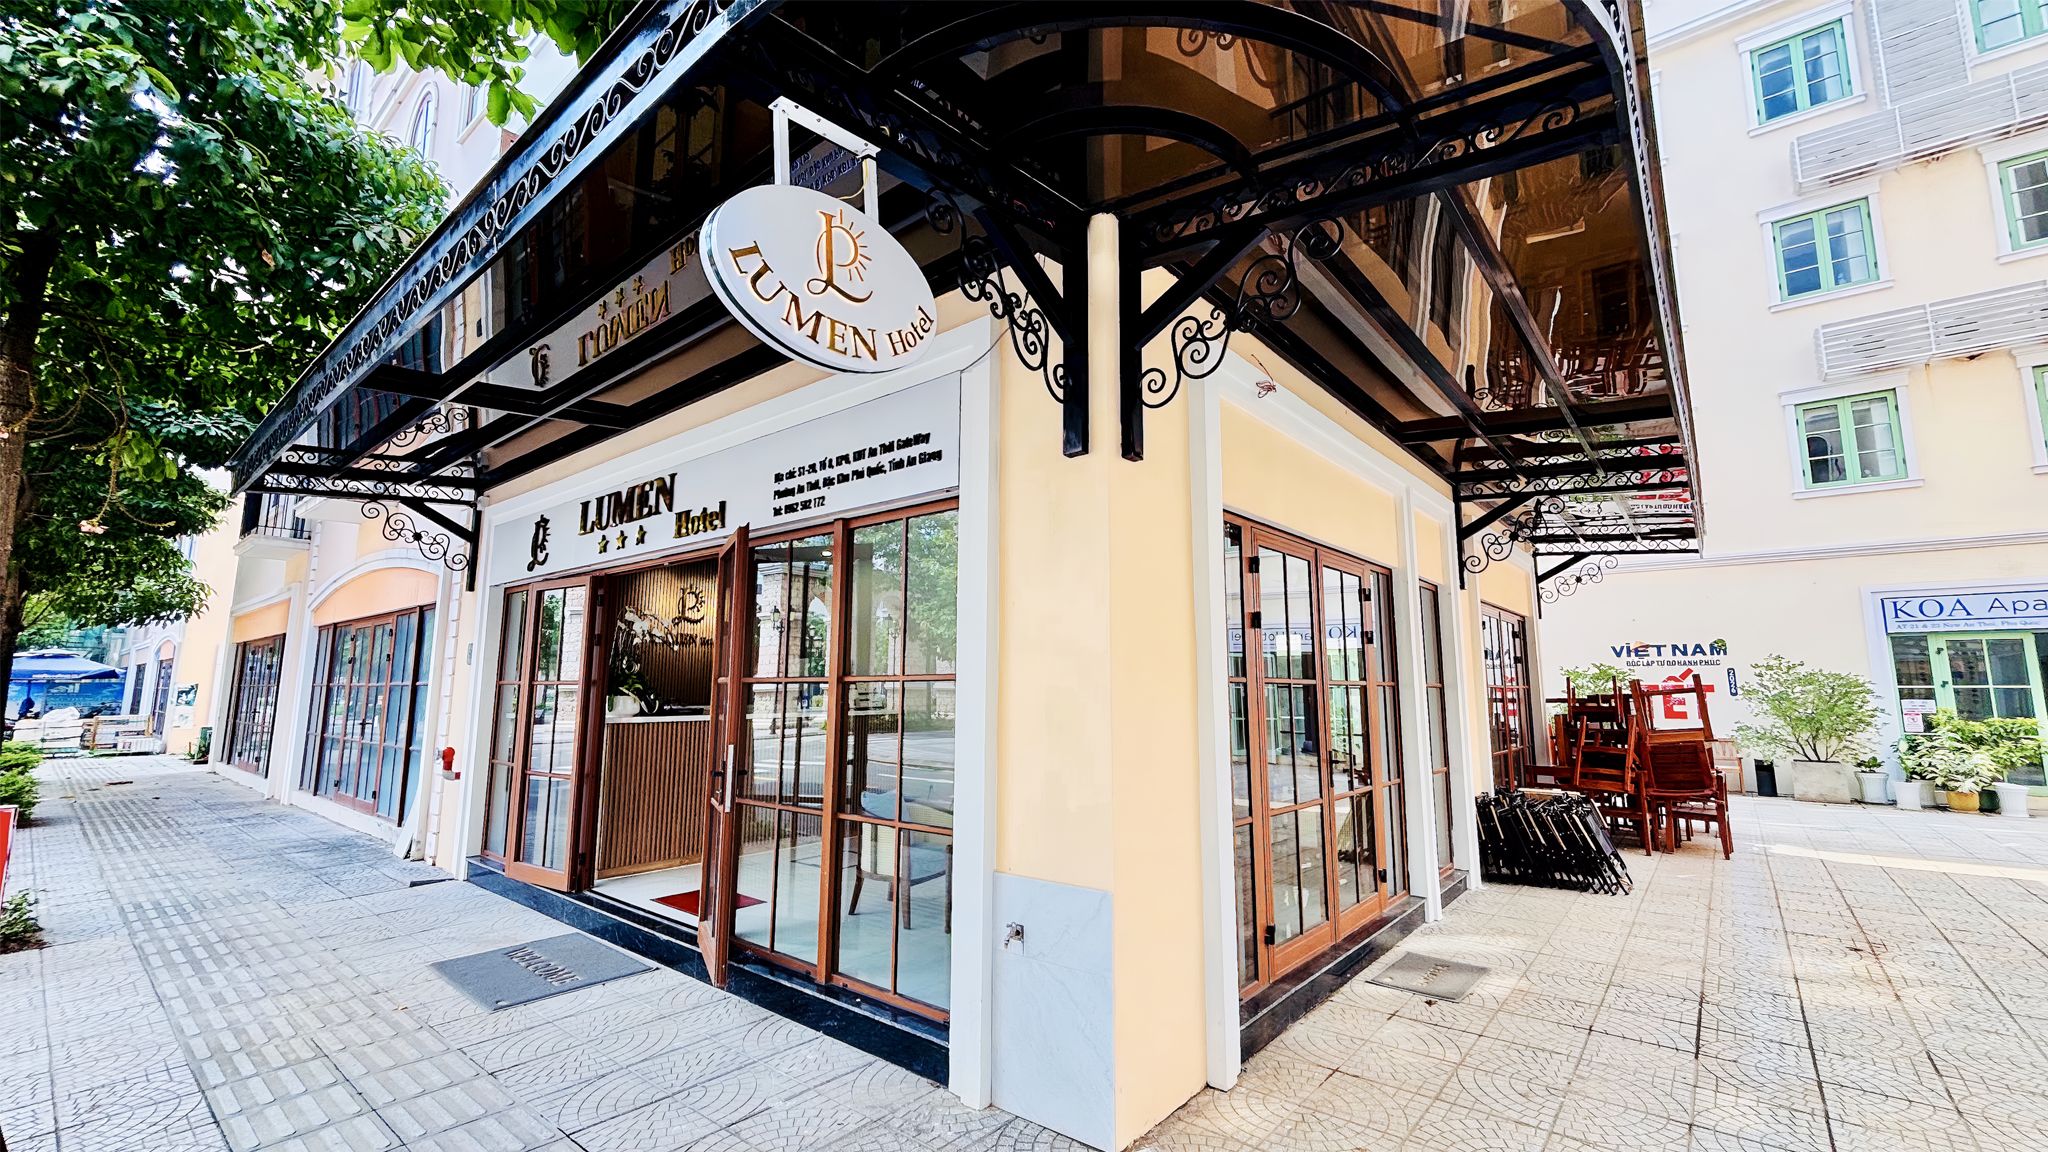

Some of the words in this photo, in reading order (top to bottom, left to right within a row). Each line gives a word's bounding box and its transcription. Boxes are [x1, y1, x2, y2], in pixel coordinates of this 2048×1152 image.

[729, 240, 878, 361] LUMEN
[885, 305, 935, 357] Hotel
[906, 455, 917, 467] An
[578, 473, 678, 536] LUMEN
[673, 500, 727, 539] Hotel
[1891, 598, 1974, 619] KOA
[1671, 639, 1727, 656] NAM
